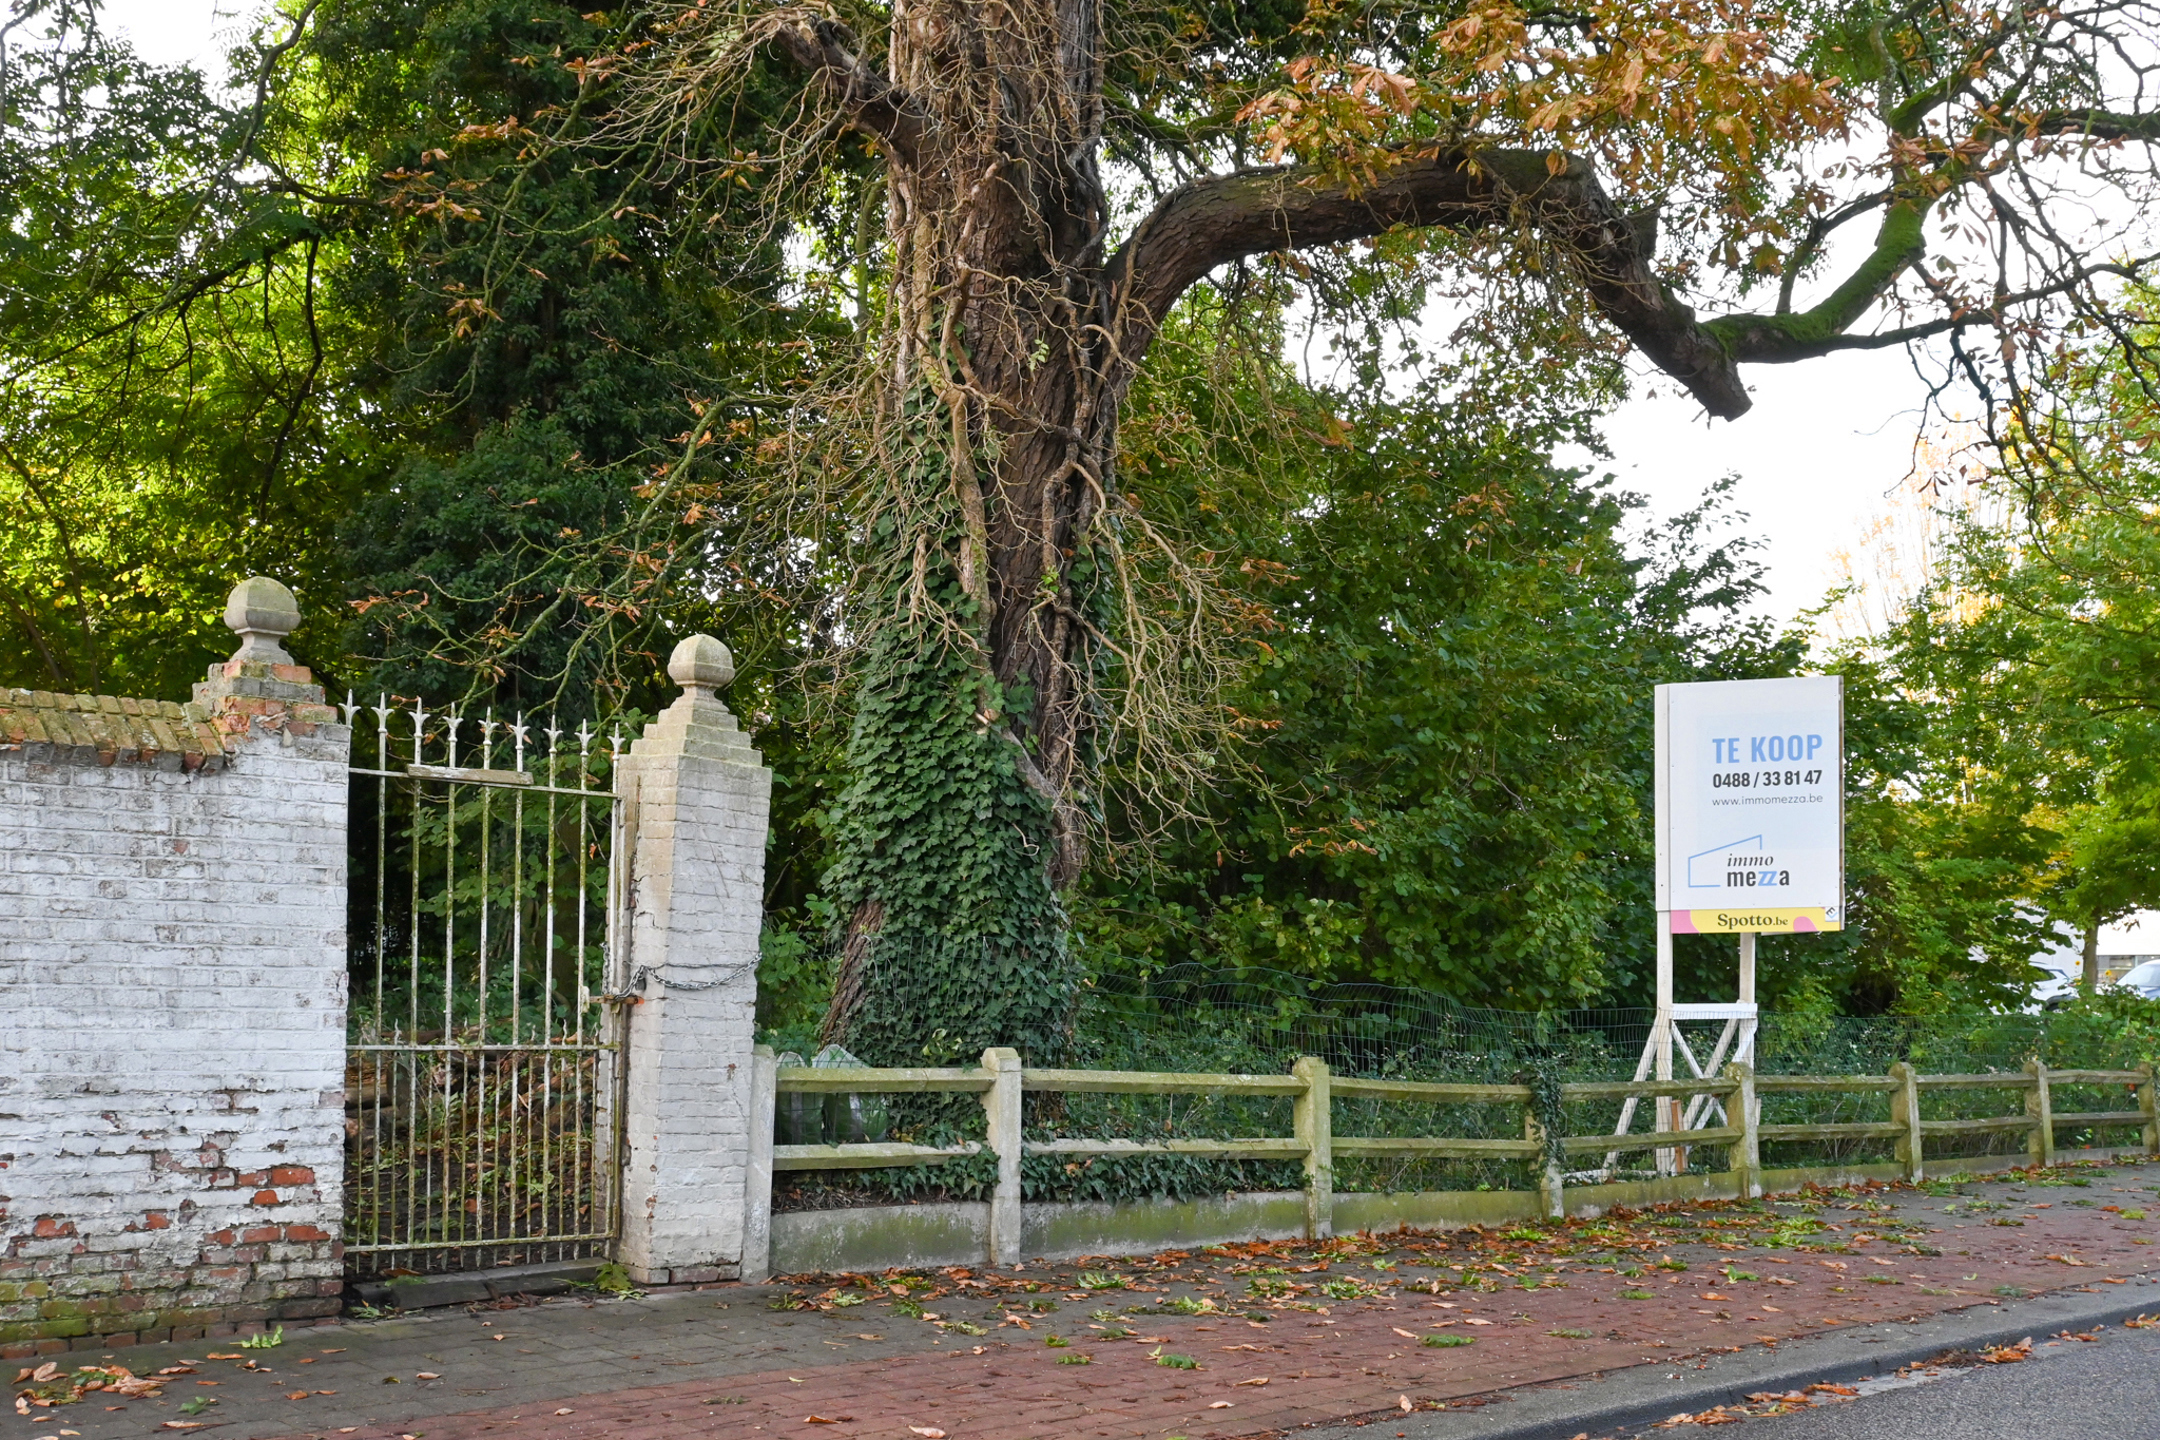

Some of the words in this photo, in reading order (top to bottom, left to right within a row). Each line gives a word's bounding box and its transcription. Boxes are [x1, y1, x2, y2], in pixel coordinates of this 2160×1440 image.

[1712, 738, 1740, 764] TE
[1751, 734, 1823, 763] KOOP
[1713, 773, 1750, 788] 0488
[1762, 771, 1781, 786] 33
[1784, 770, 1801, 785] 81
[1804, 769, 1822, 784] 47
[1712, 793, 1824, 806] www.immomezza.be
[1727, 853, 1774, 867] immo
[1727, 870, 1790, 887] mezza
[1717, 913, 1789, 930] Spotto.be
